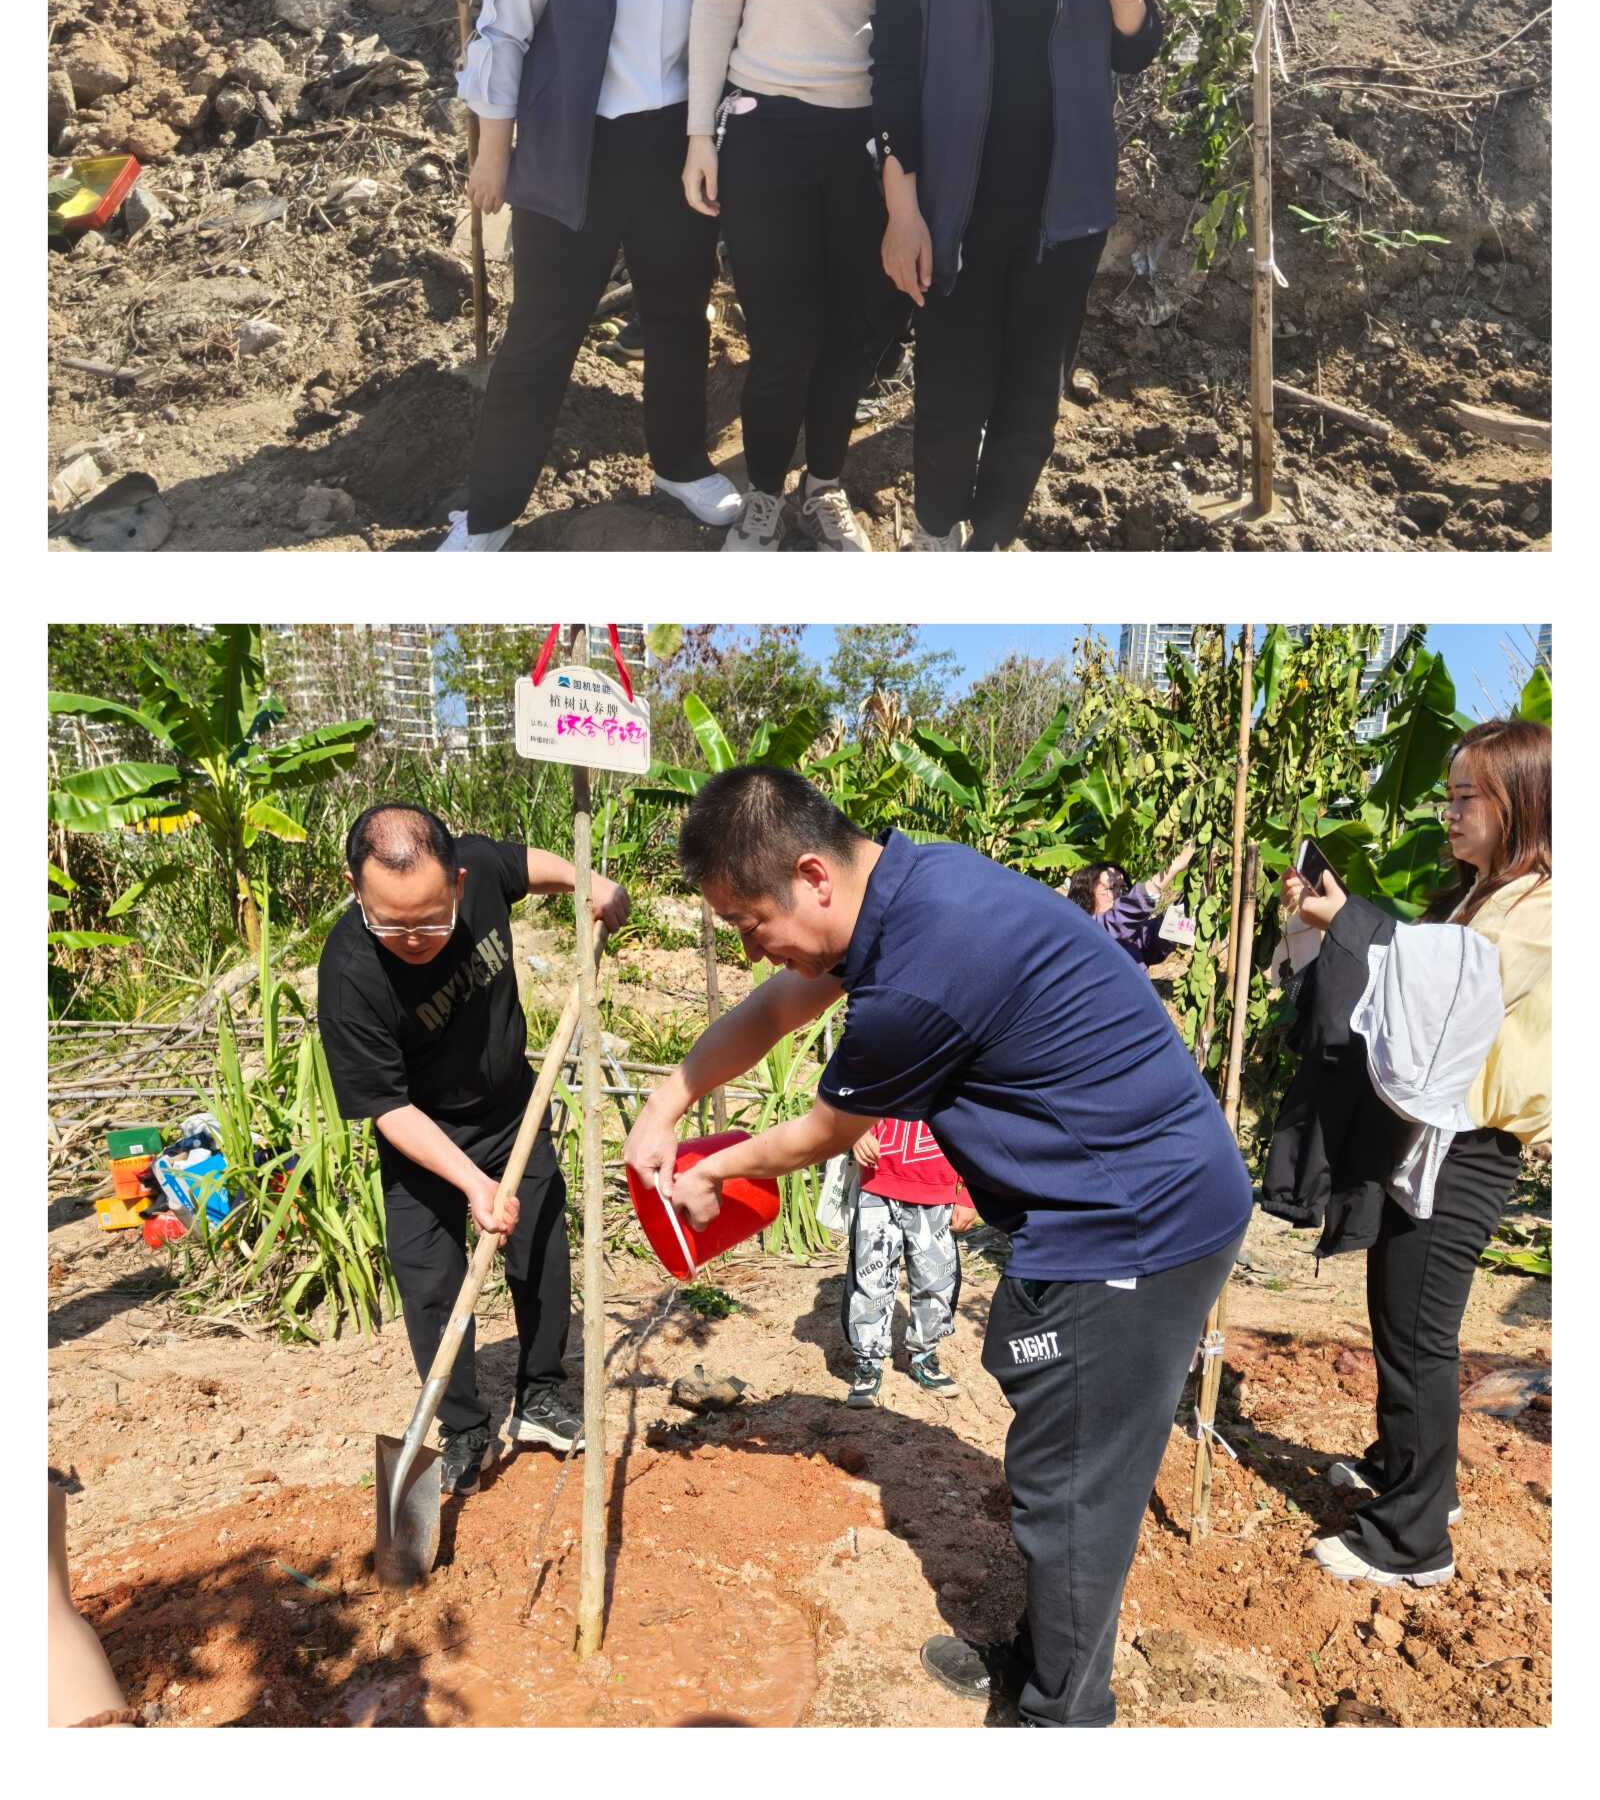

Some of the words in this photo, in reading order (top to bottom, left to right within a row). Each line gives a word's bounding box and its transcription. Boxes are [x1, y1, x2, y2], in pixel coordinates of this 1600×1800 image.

[573, 679, 613, 695] 国机智能
[550, 693, 619, 717] 植树认养牌
[858, 1259, 884, 1279] HERO
